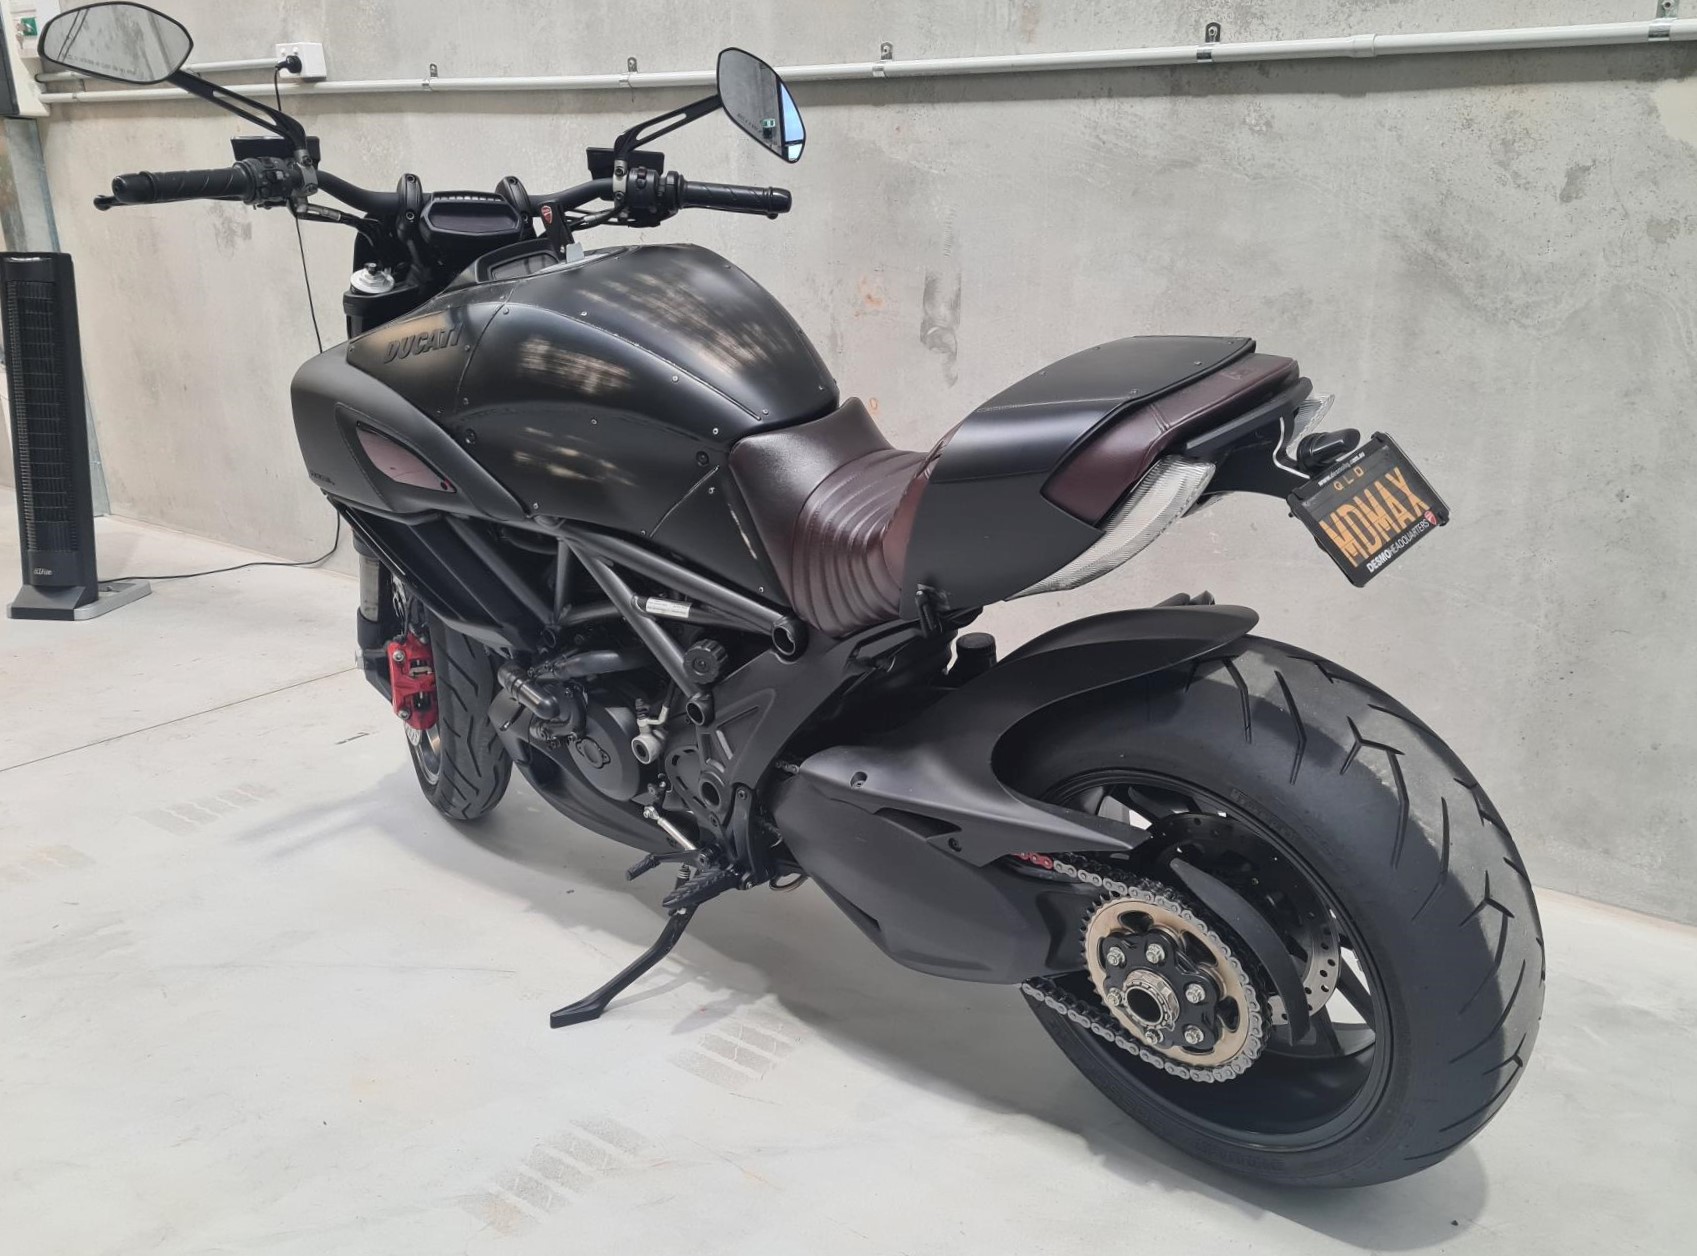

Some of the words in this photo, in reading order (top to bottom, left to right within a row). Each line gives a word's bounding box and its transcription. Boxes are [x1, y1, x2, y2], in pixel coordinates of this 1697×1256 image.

[384, 321, 463, 364] DUCATI
[1333, 466, 1364, 490] QLD
[1319, 467, 1430, 568] MDMAX
